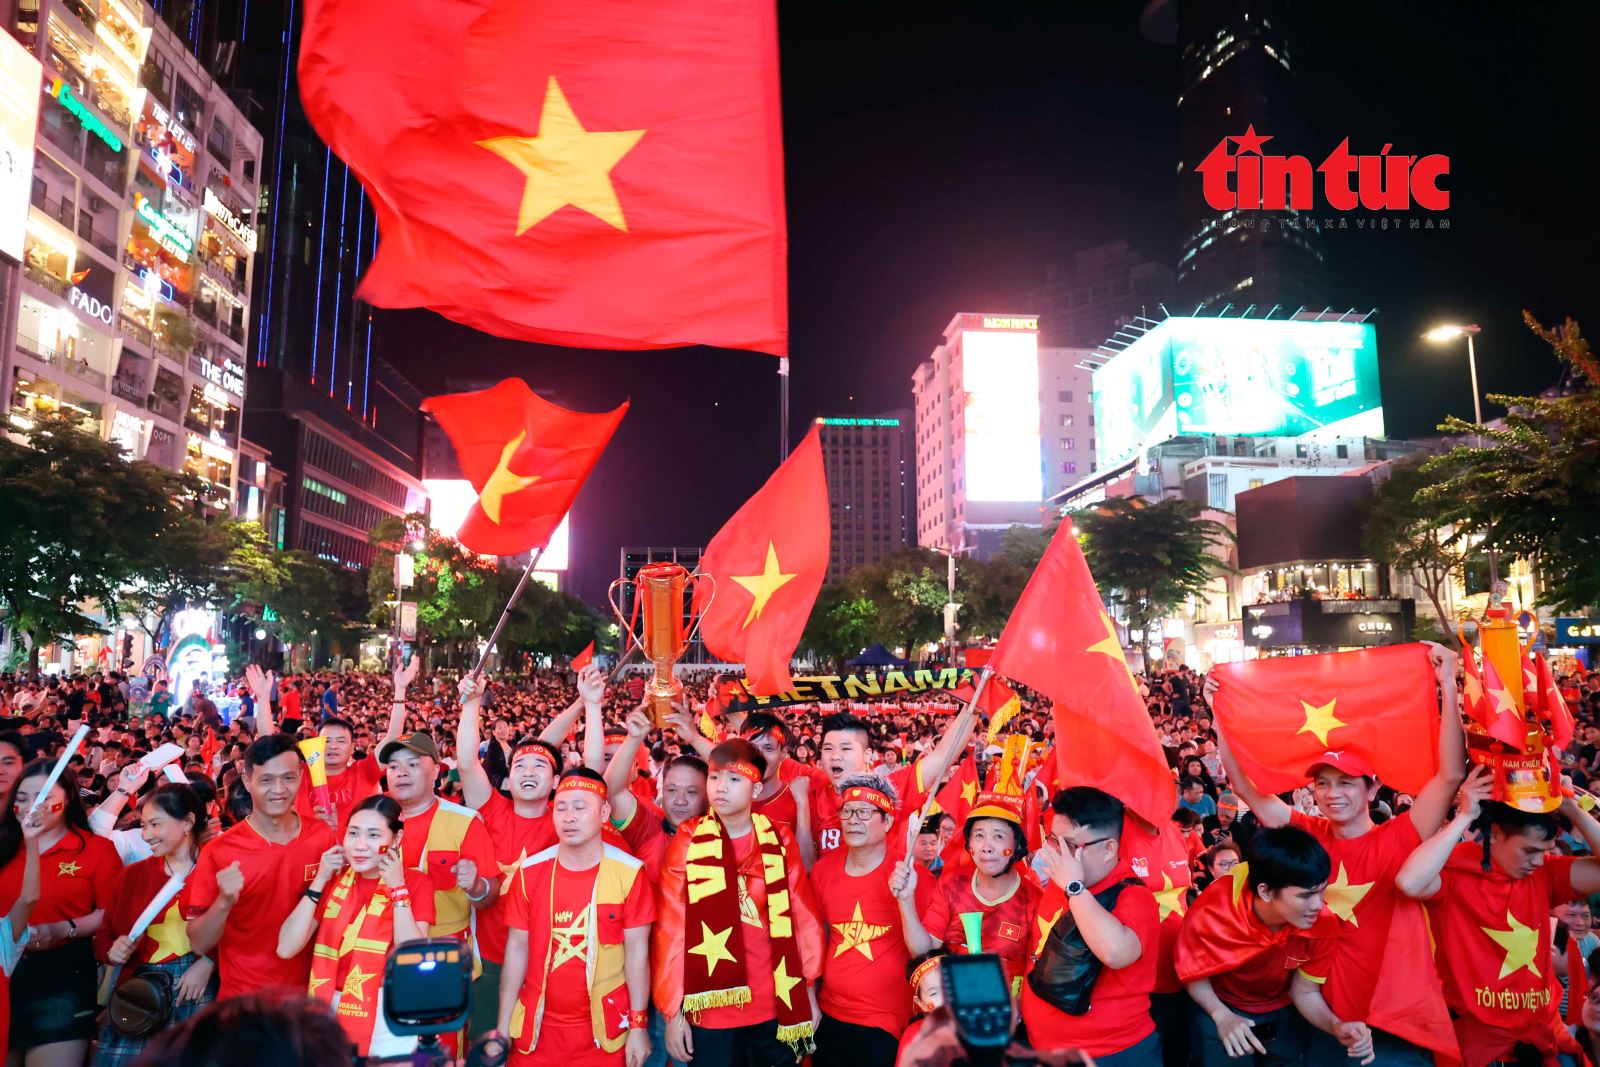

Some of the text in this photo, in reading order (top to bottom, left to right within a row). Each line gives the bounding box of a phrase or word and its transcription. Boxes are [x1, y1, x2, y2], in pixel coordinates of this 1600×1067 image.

[70, 286, 112, 324] FADO
[200, 357, 222, 385] THE
[222, 371, 244, 397] ONE
[857, 417, 874, 426] VIEW
[875, 418, 899, 427] TOWER
[1503, 760, 1520, 768] NAM
[821, 828, 841, 850] 19
[555, 911, 573, 923] NAM
[1475, 986, 1496, 1008] TÔI
[1497, 987, 1520, 1010] YÊU
[1520, 987, 1541, 1013] VIỆT
